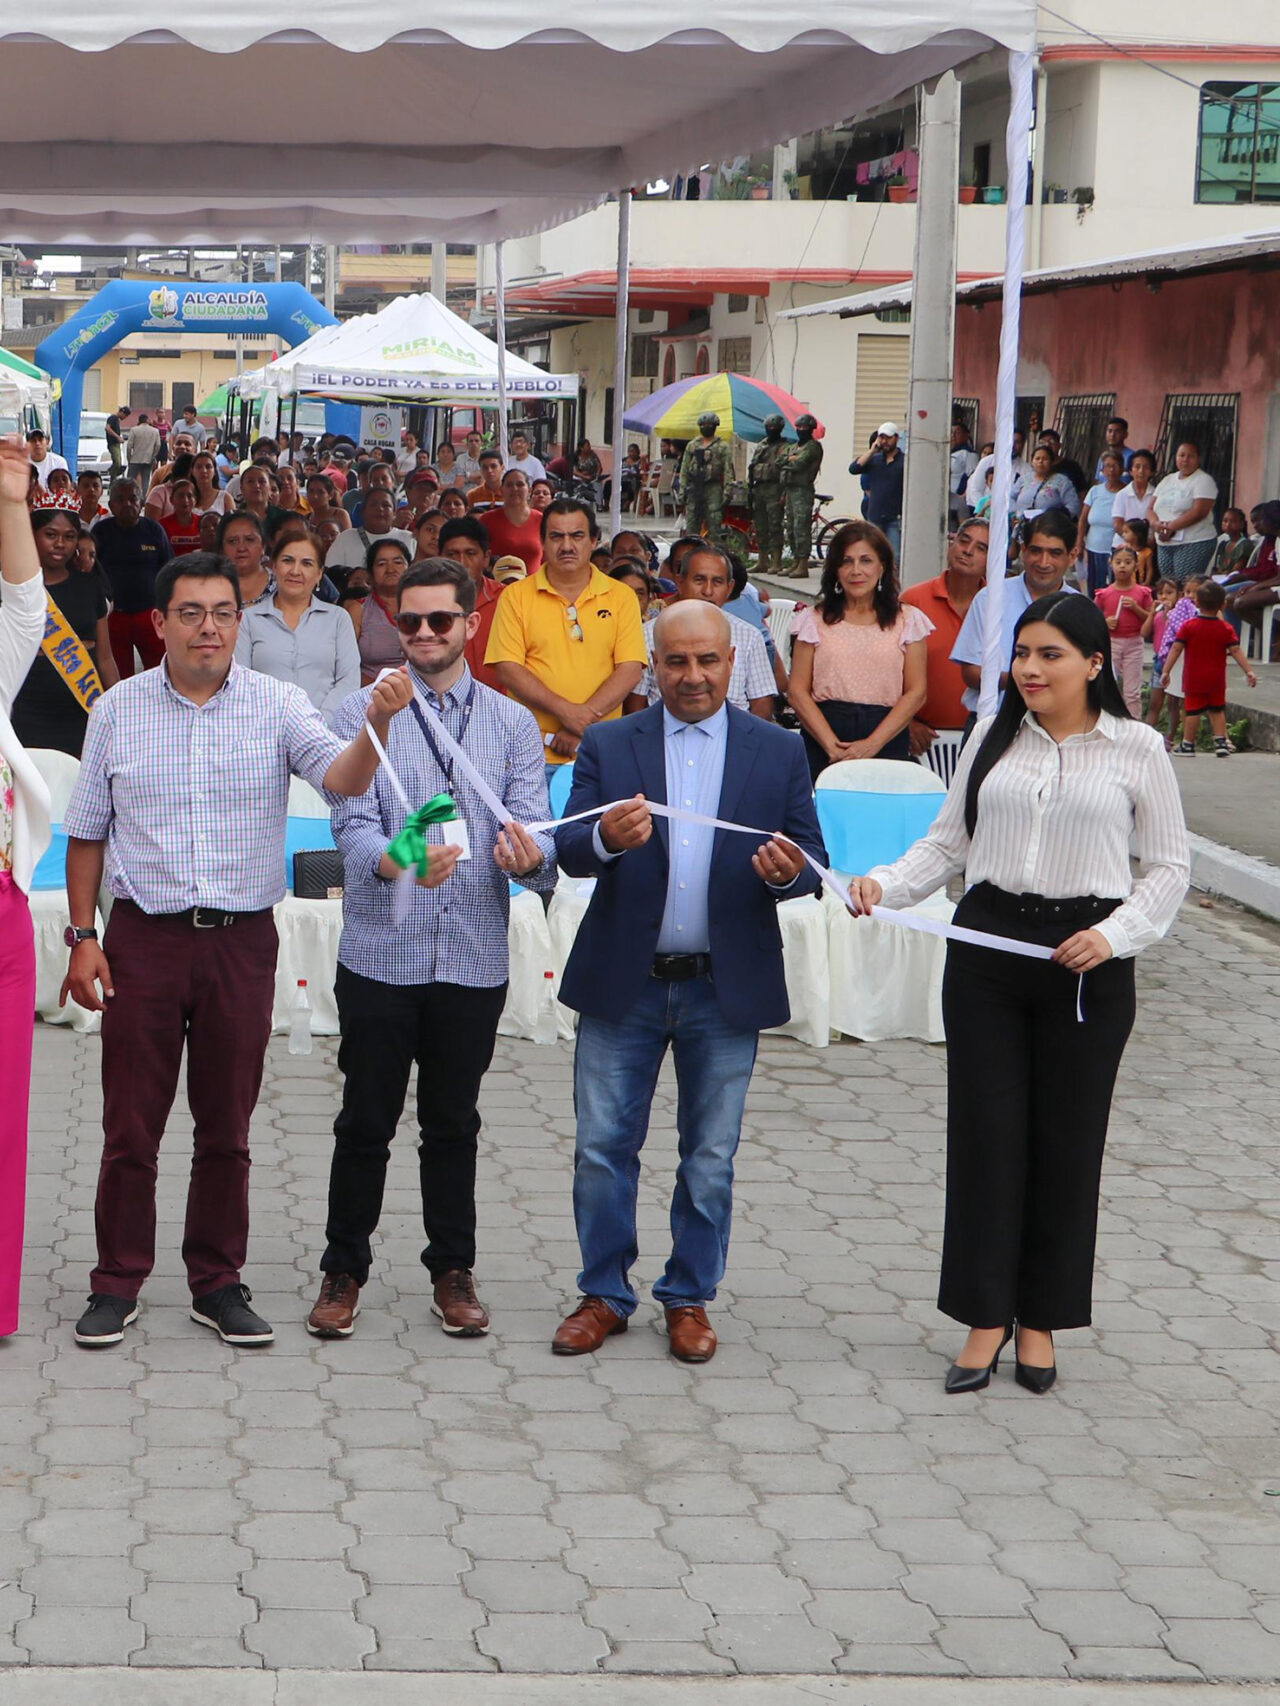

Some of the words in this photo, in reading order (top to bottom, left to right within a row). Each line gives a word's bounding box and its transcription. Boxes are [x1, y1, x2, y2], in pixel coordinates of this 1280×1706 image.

[184, 290, 266, 304] ALCALDÍA
[183, 305, 267, 315] CIUDADANA
[341, 375, 399, 388] PODER
[403, 379, 425, 389] YA
[455, 381, 487, 391] DEL
